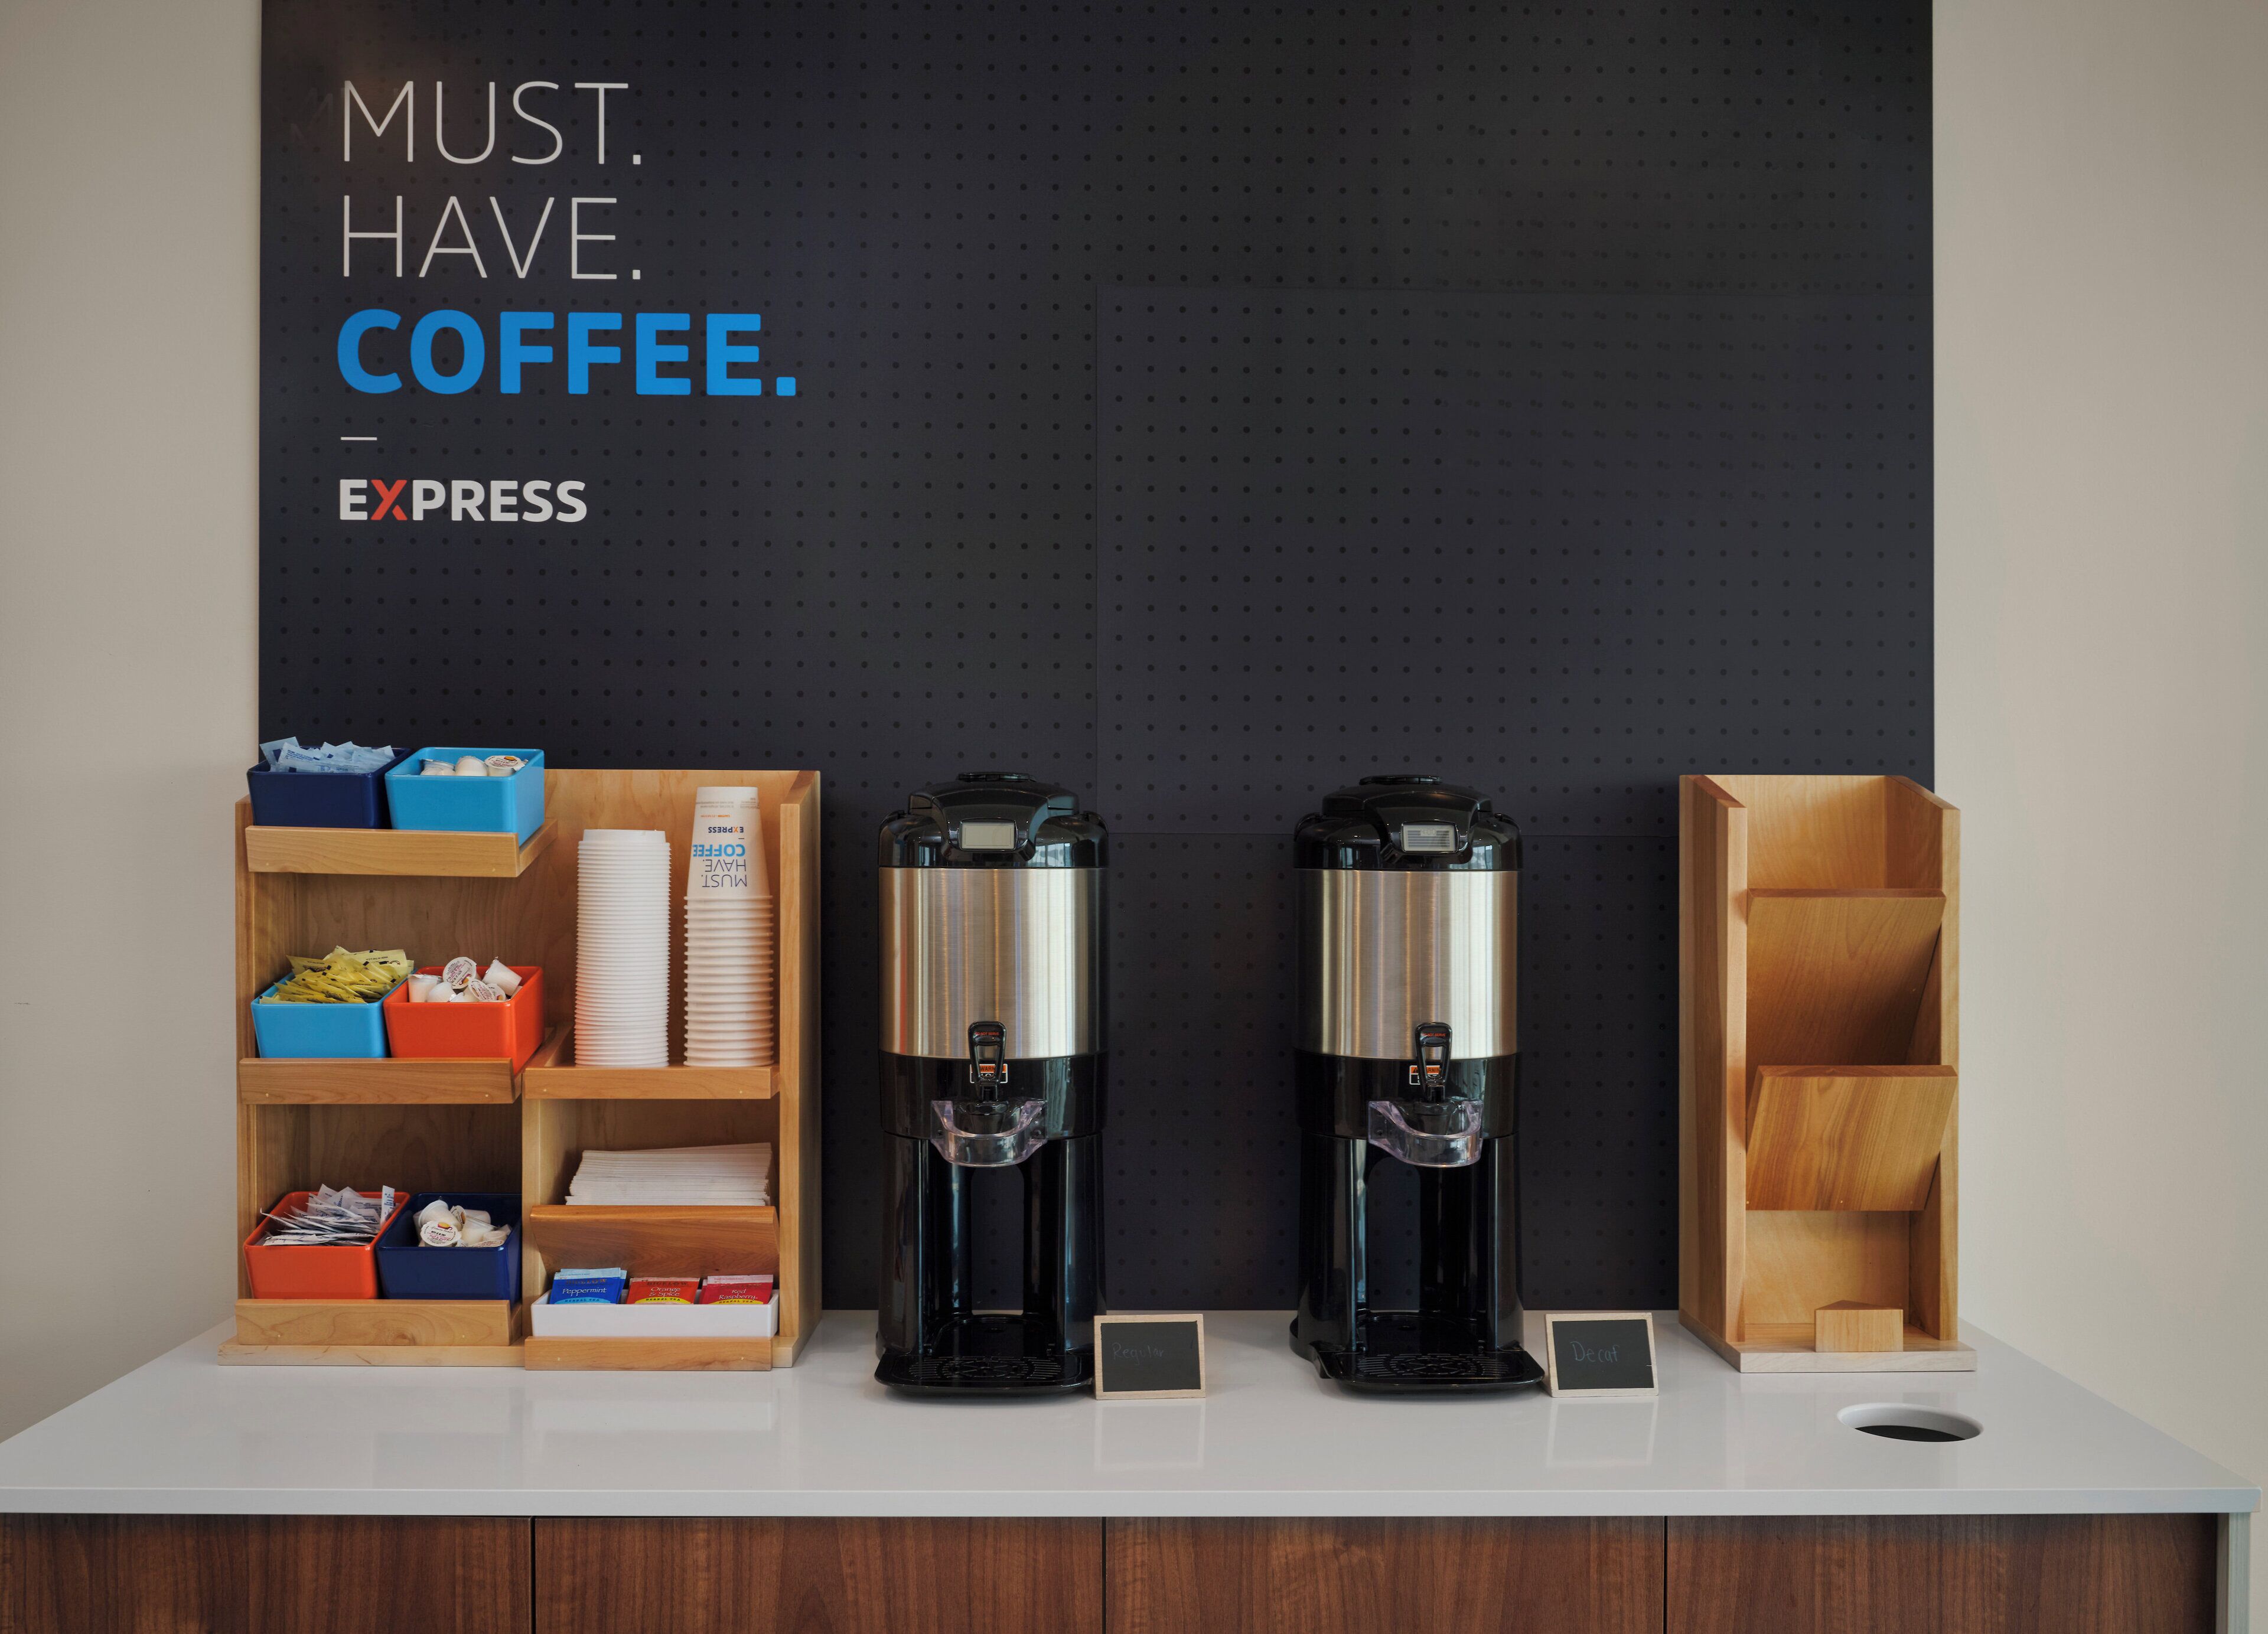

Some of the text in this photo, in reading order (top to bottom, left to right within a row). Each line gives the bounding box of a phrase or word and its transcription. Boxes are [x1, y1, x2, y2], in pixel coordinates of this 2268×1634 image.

[344, 80, 641, 165] MUST.
[343, 195, 641, 280] HAVE.
[337, 308, 797, 396] COFFEE.
[339, 479, 588, 523] EXPRESS
[702, 859, 747, 872] HAVE.
[701, 874, 747, 888] MUST.
[562, 1287, 607, 1297] Peppermint
[1112, 1341, 1165, 1365] Regular
[1569, 1341, 1621, 1364] Decaf
